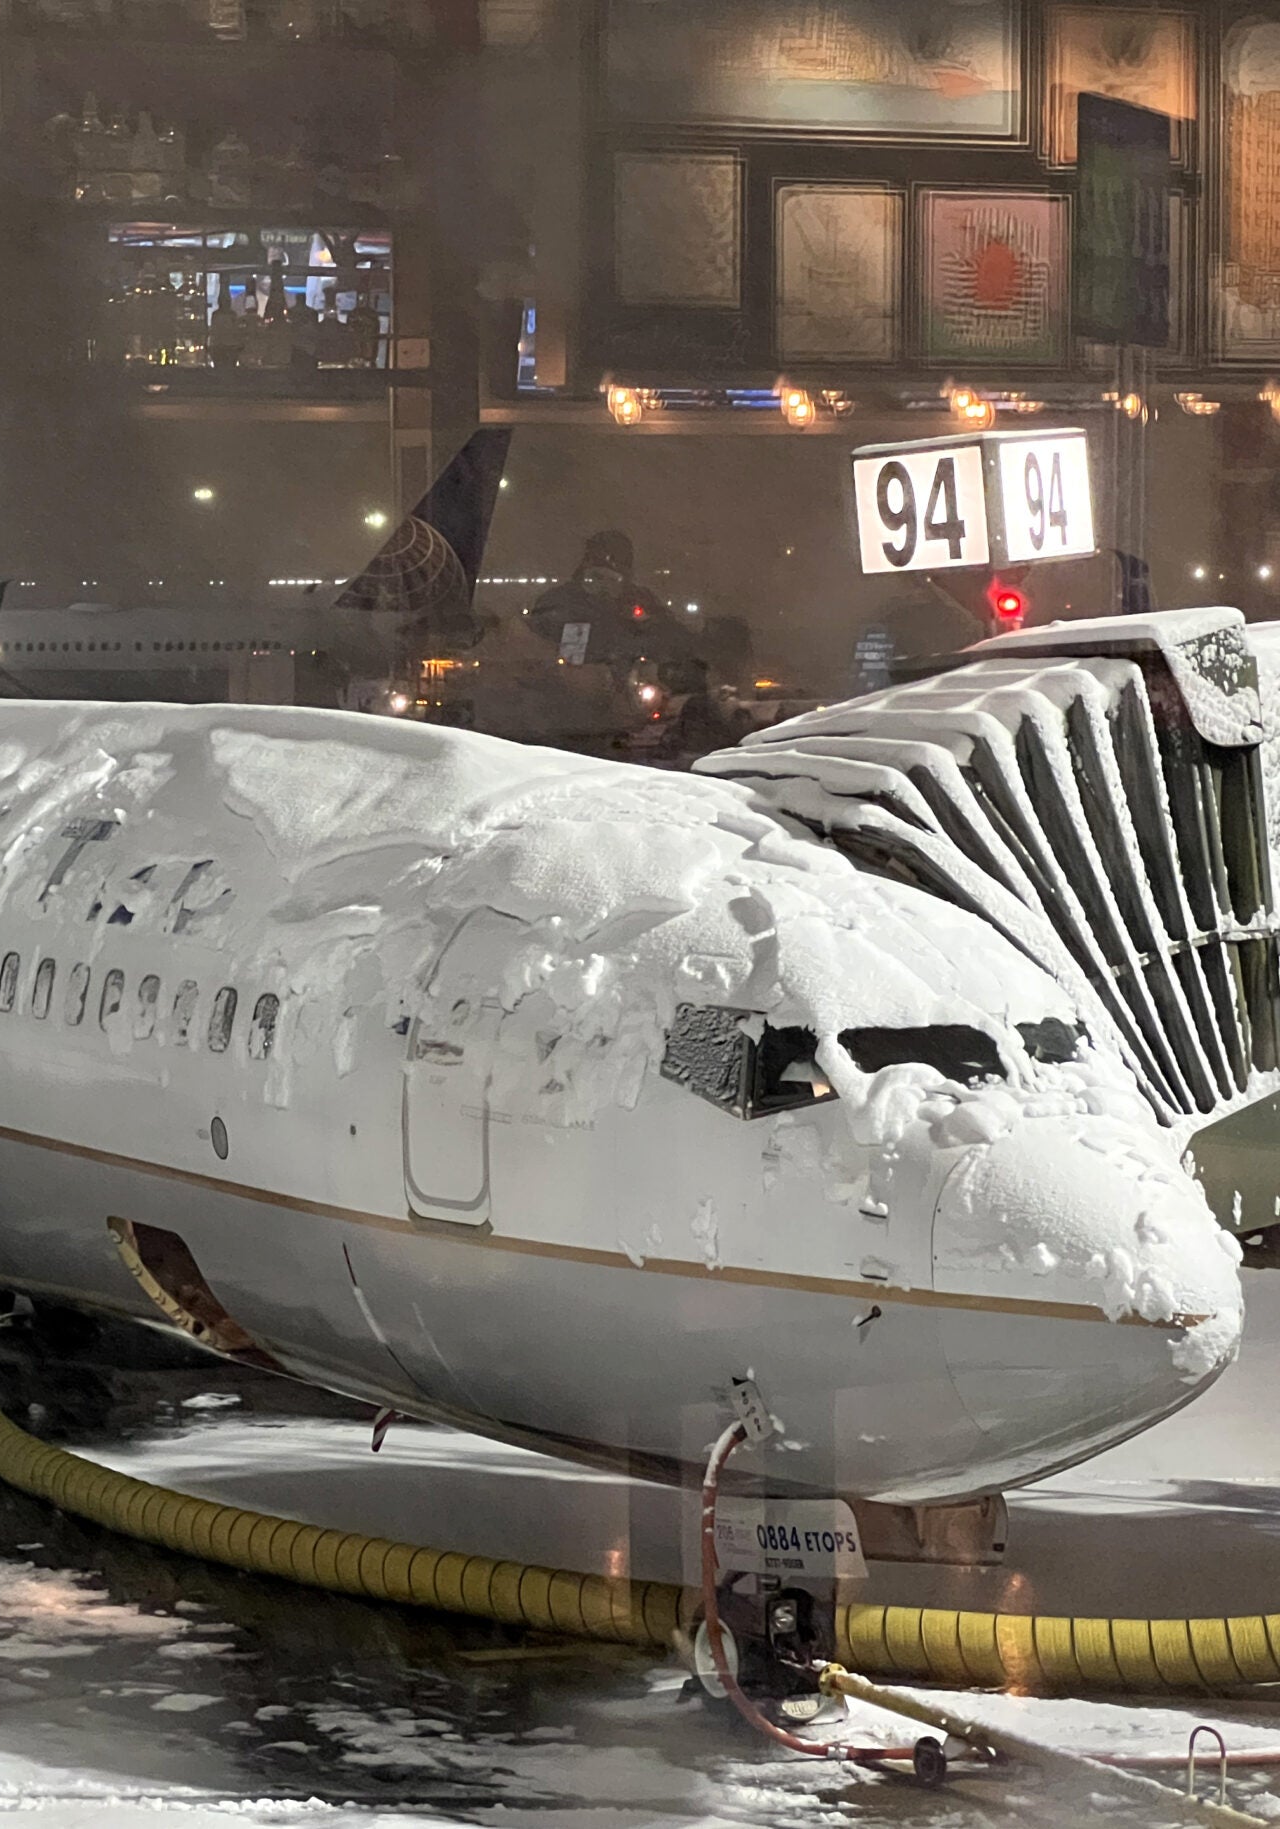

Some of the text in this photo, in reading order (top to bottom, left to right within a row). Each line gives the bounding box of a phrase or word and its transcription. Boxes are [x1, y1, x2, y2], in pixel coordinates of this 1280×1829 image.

[876, 457, 966, 567] 94
[1025, 452, 1069, 551] 94
[756, 1524, 801, 1551] 0884
[805, 1531, 856, 1552] ETOPS
